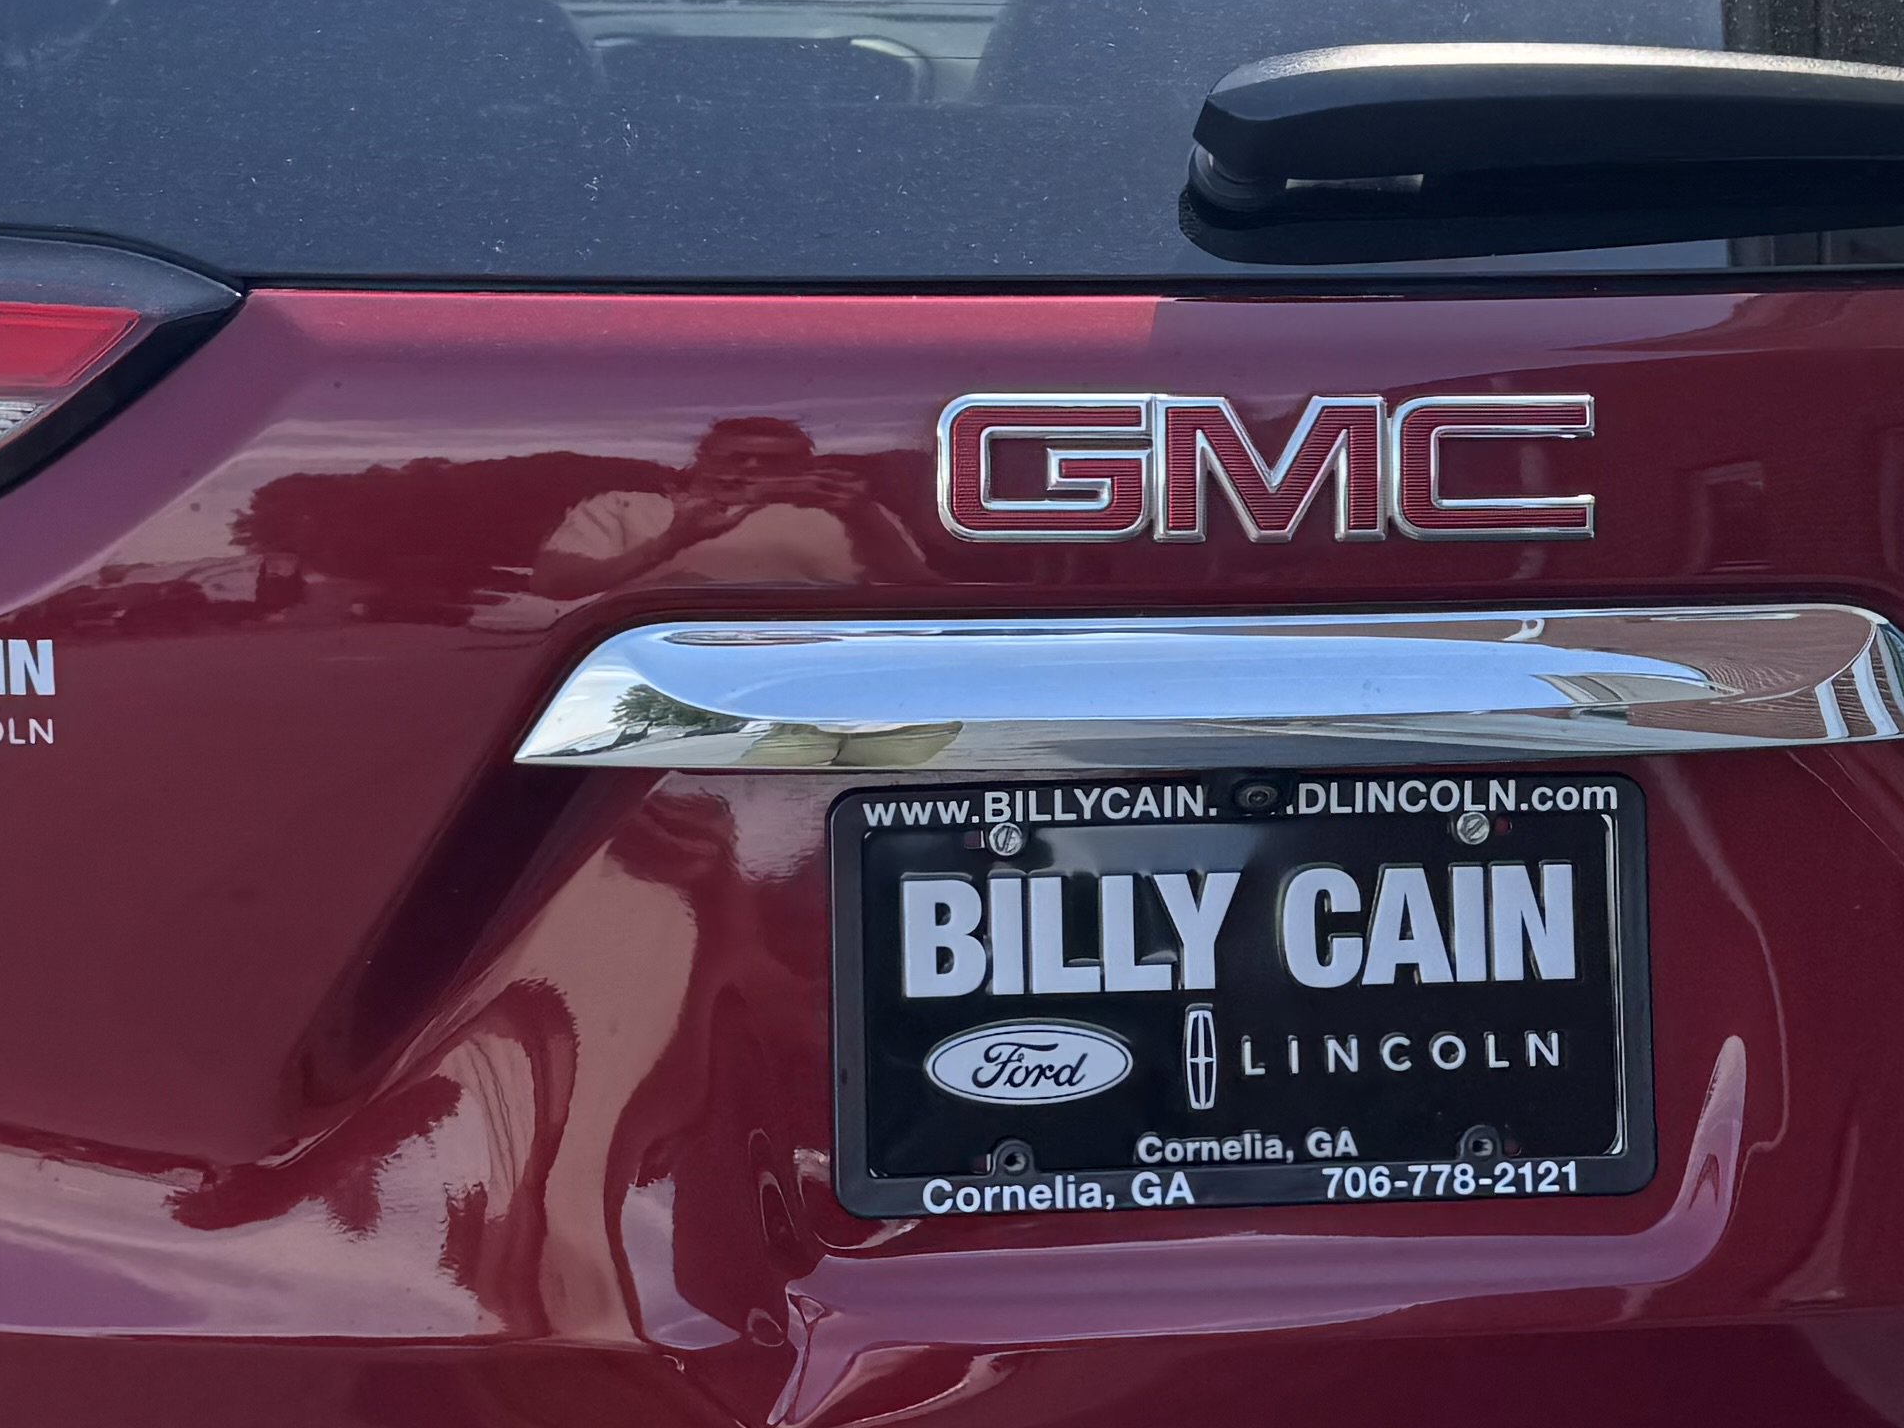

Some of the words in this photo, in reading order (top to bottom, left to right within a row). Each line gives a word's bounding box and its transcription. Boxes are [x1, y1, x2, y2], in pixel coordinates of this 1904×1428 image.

[937, 393, 1595, 544] GMC
[900, 871, 1241, 999] BILLY
[1283, 863, 1577, 988] CAIN
[972, 1041, 1086, 1089] Ford
[1244, 1032, 1561, 1076] LINCOLN
[1137, 1133, 1294, 1164] Cornelia,
[1306, 1130, 1358, 1158] GA
[922, 1174, 1115, 1214] Cornelia,
[1131, 1171, 1195, 1206] GA
[1321, 1160, 1577, 1199] 706-778-2121
